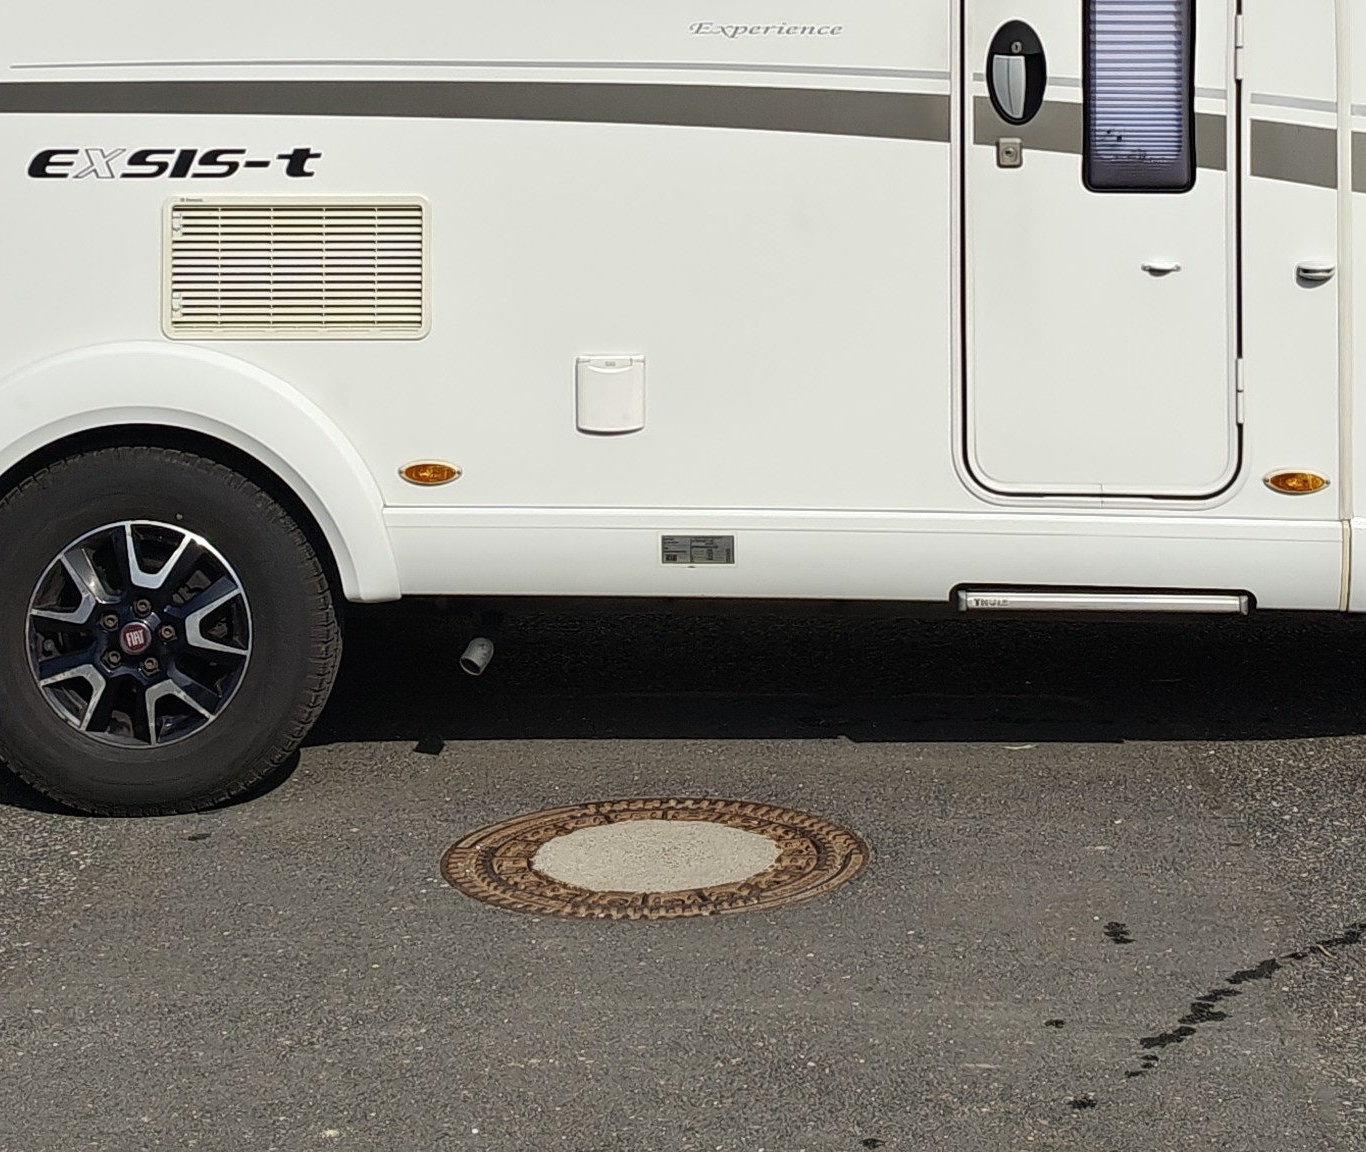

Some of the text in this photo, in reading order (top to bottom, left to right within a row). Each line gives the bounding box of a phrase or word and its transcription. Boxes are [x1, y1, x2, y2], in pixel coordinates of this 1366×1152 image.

[689, 22, 843, 39] Experience
[27, 148, 323, 179] EXSIS-t
[974, 598, 1009, 607] THULE
[125, 629, 145, 647] FIAT
